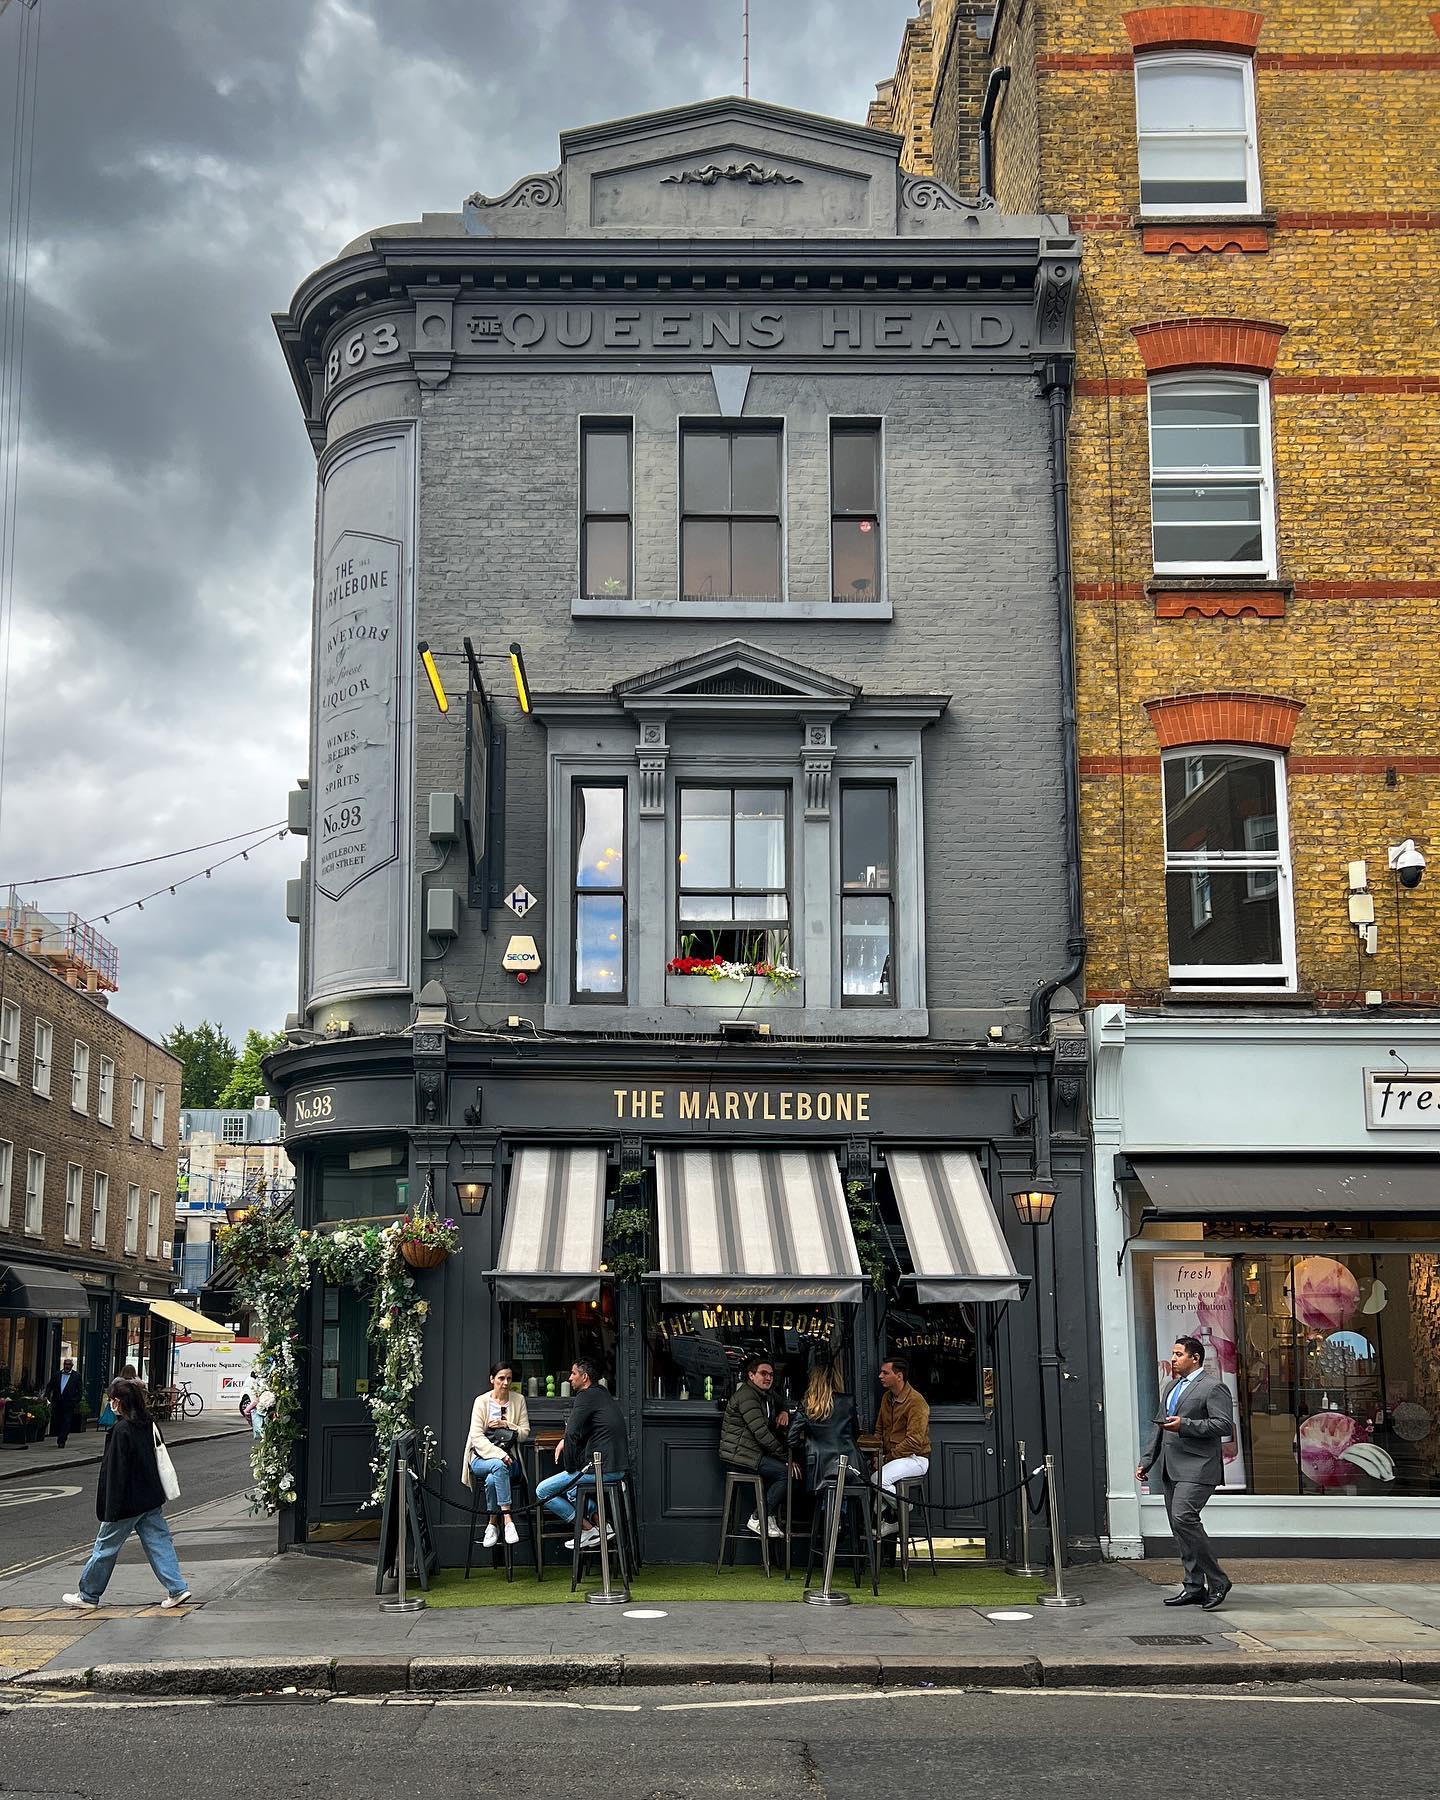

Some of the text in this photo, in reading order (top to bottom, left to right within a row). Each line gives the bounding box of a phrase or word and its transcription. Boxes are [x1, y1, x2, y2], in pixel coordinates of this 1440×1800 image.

[501, 308, 785, 353] QUEENS
[336, 558, 354, 582] THE
[336, 763, 344, 774] &
[325, 773, 360, 794] SPIRITS
[323, 805, 362, 838] No.93
[512, 892, 528, 909] H
[295, 1095, 332, 1121] No.93
[613, 1090, 871, 1121] THE MARYLEBONE
[1380, 1081, 1440, 1118] fre
[1177, 1265, 1212, 1282] fresh
[1174, 1289, 1197, 1301] Triple
[1167, 1302, 1187, 1314] deep
[656, 1313, 695, 1340] THE
[943, 1335, 966, 1349] BAR
